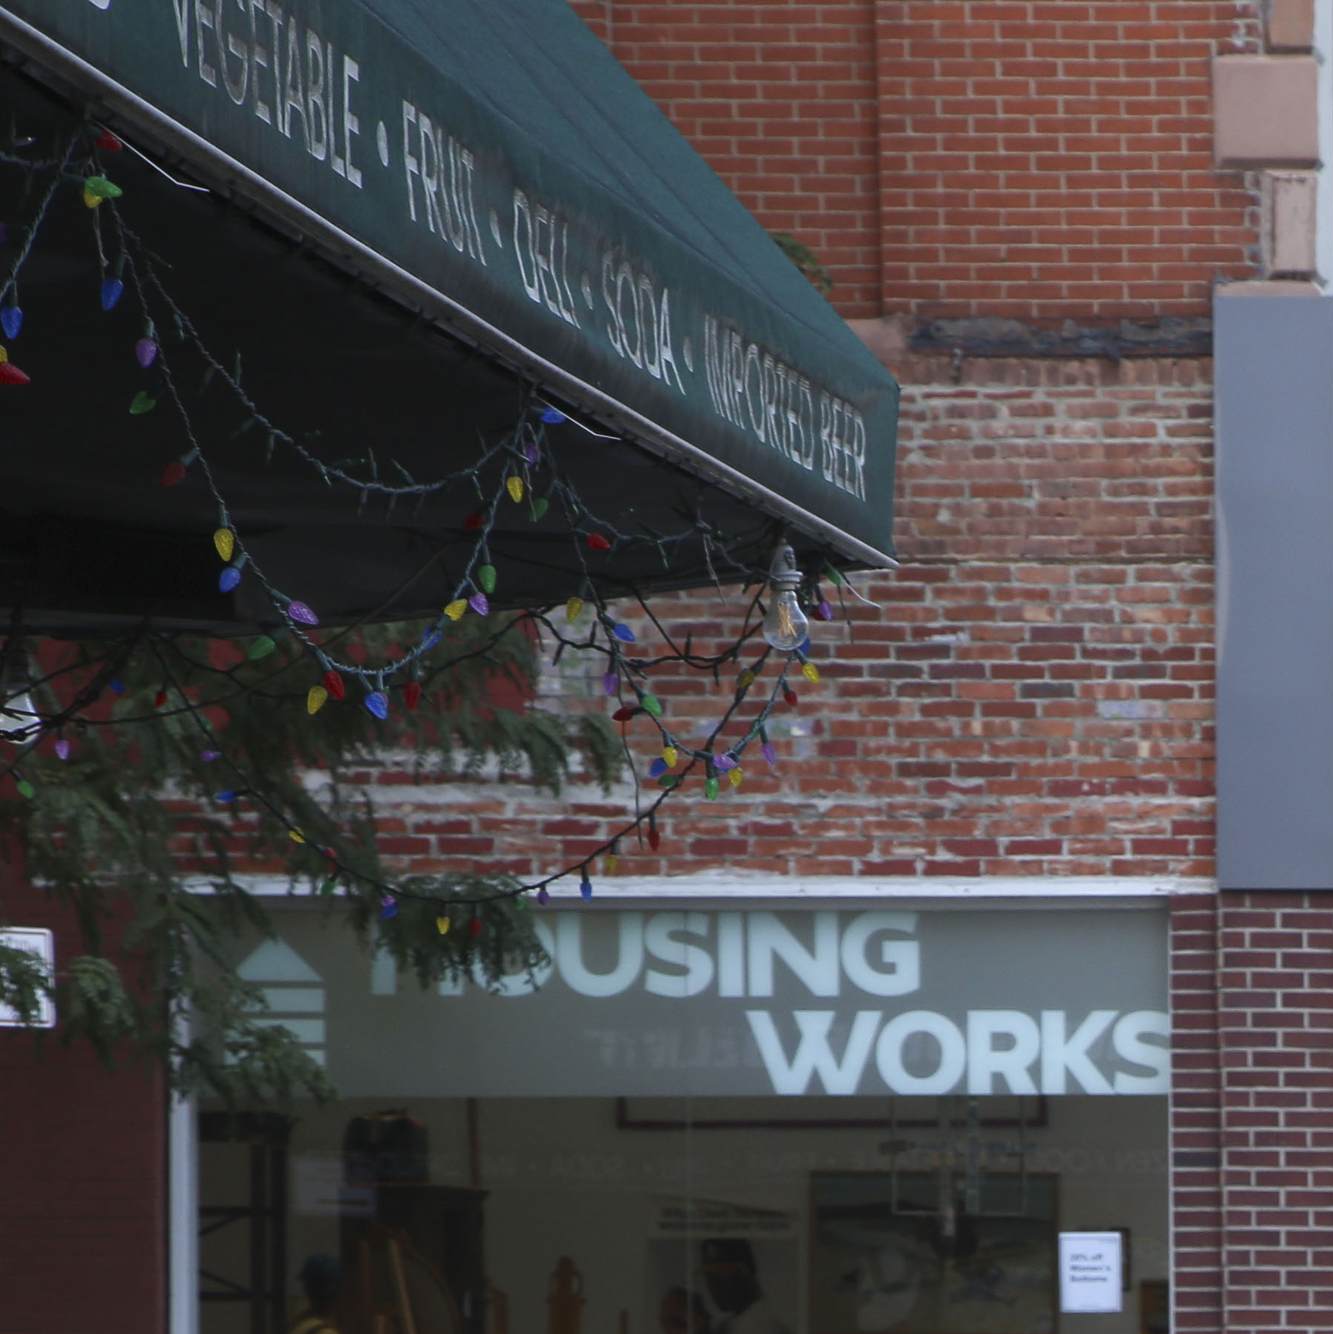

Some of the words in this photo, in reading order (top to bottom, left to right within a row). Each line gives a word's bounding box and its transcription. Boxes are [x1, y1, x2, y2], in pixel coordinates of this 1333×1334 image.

[402, 100, 487, 267] FRUIT
[512, 187, 581, 330] DELI
[601, 250, 686, 395] SODA
[704, 315, 813, 471] IMPORTED
[819, 390, 867, 502] BEER
[745, 1010, 1171, 1095] WORKS
